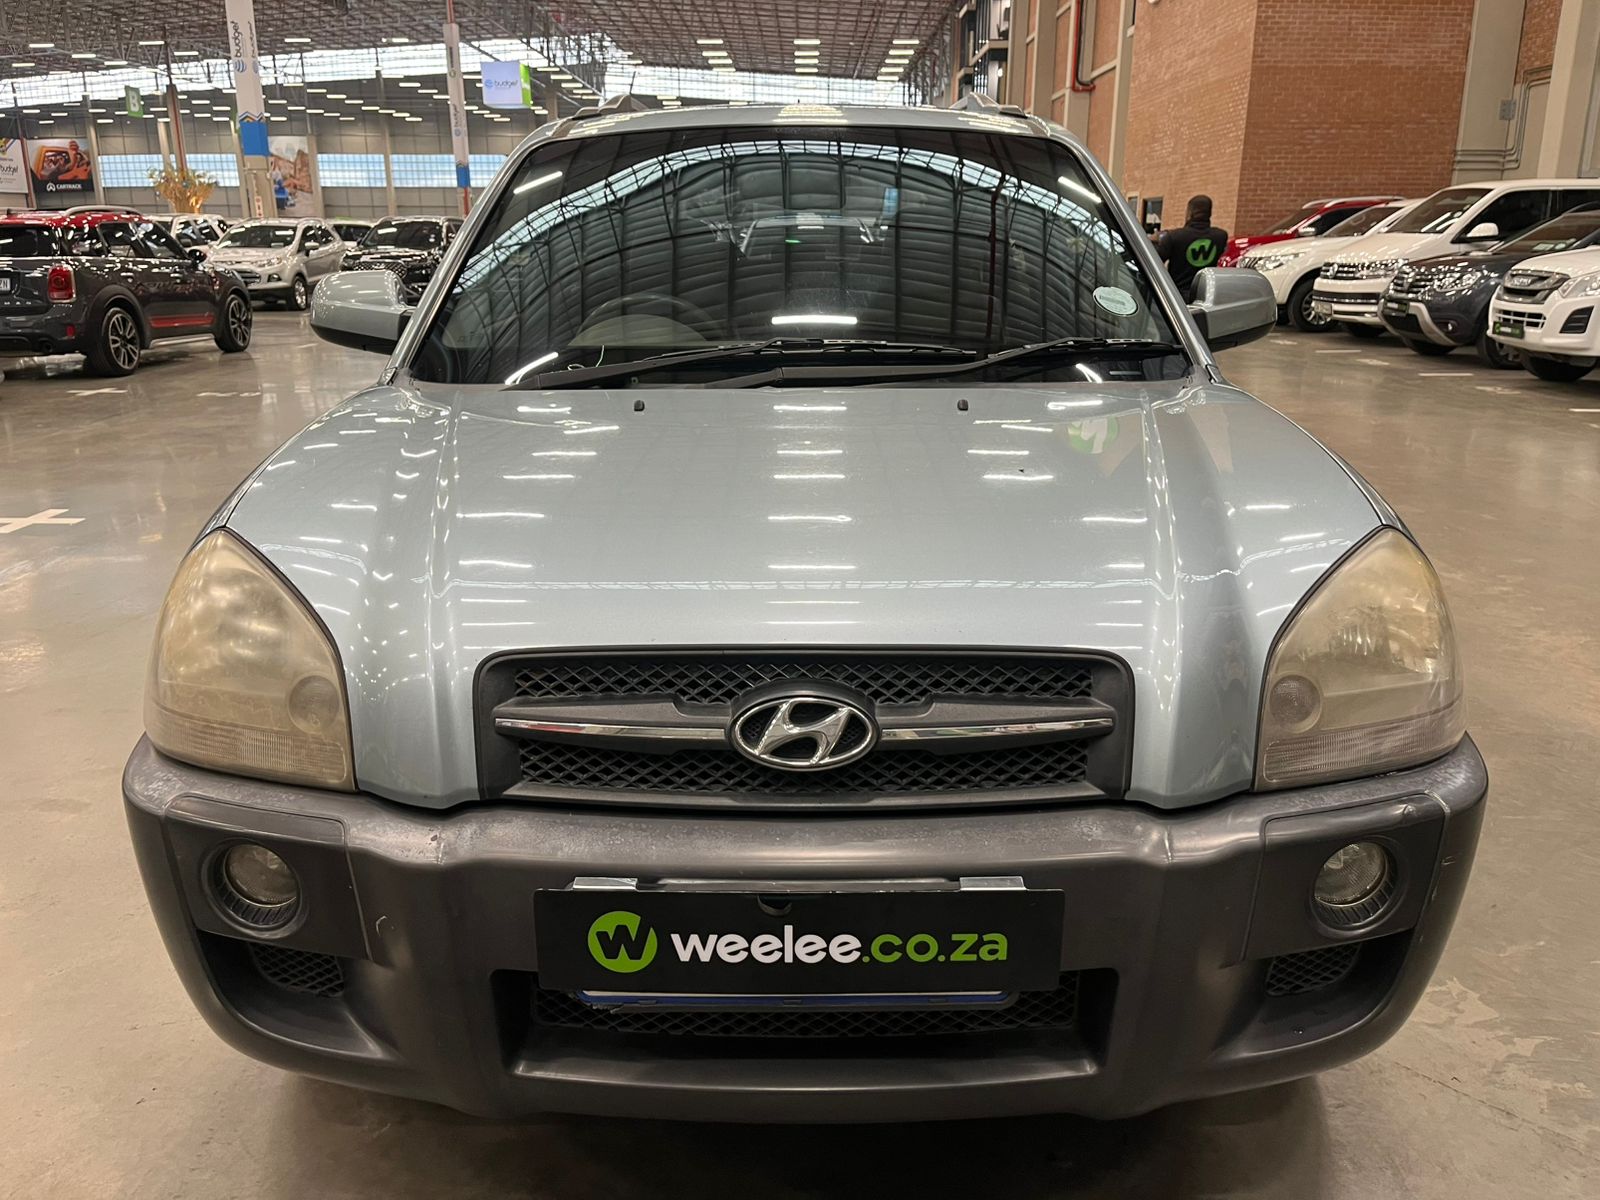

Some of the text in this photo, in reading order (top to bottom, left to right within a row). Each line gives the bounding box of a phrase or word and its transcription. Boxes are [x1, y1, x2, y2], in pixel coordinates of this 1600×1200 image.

[230, 21, 243, 57] budget
[129, 90, 140, 112] B
[670, 925, 1008, 964] weelee.co.za
